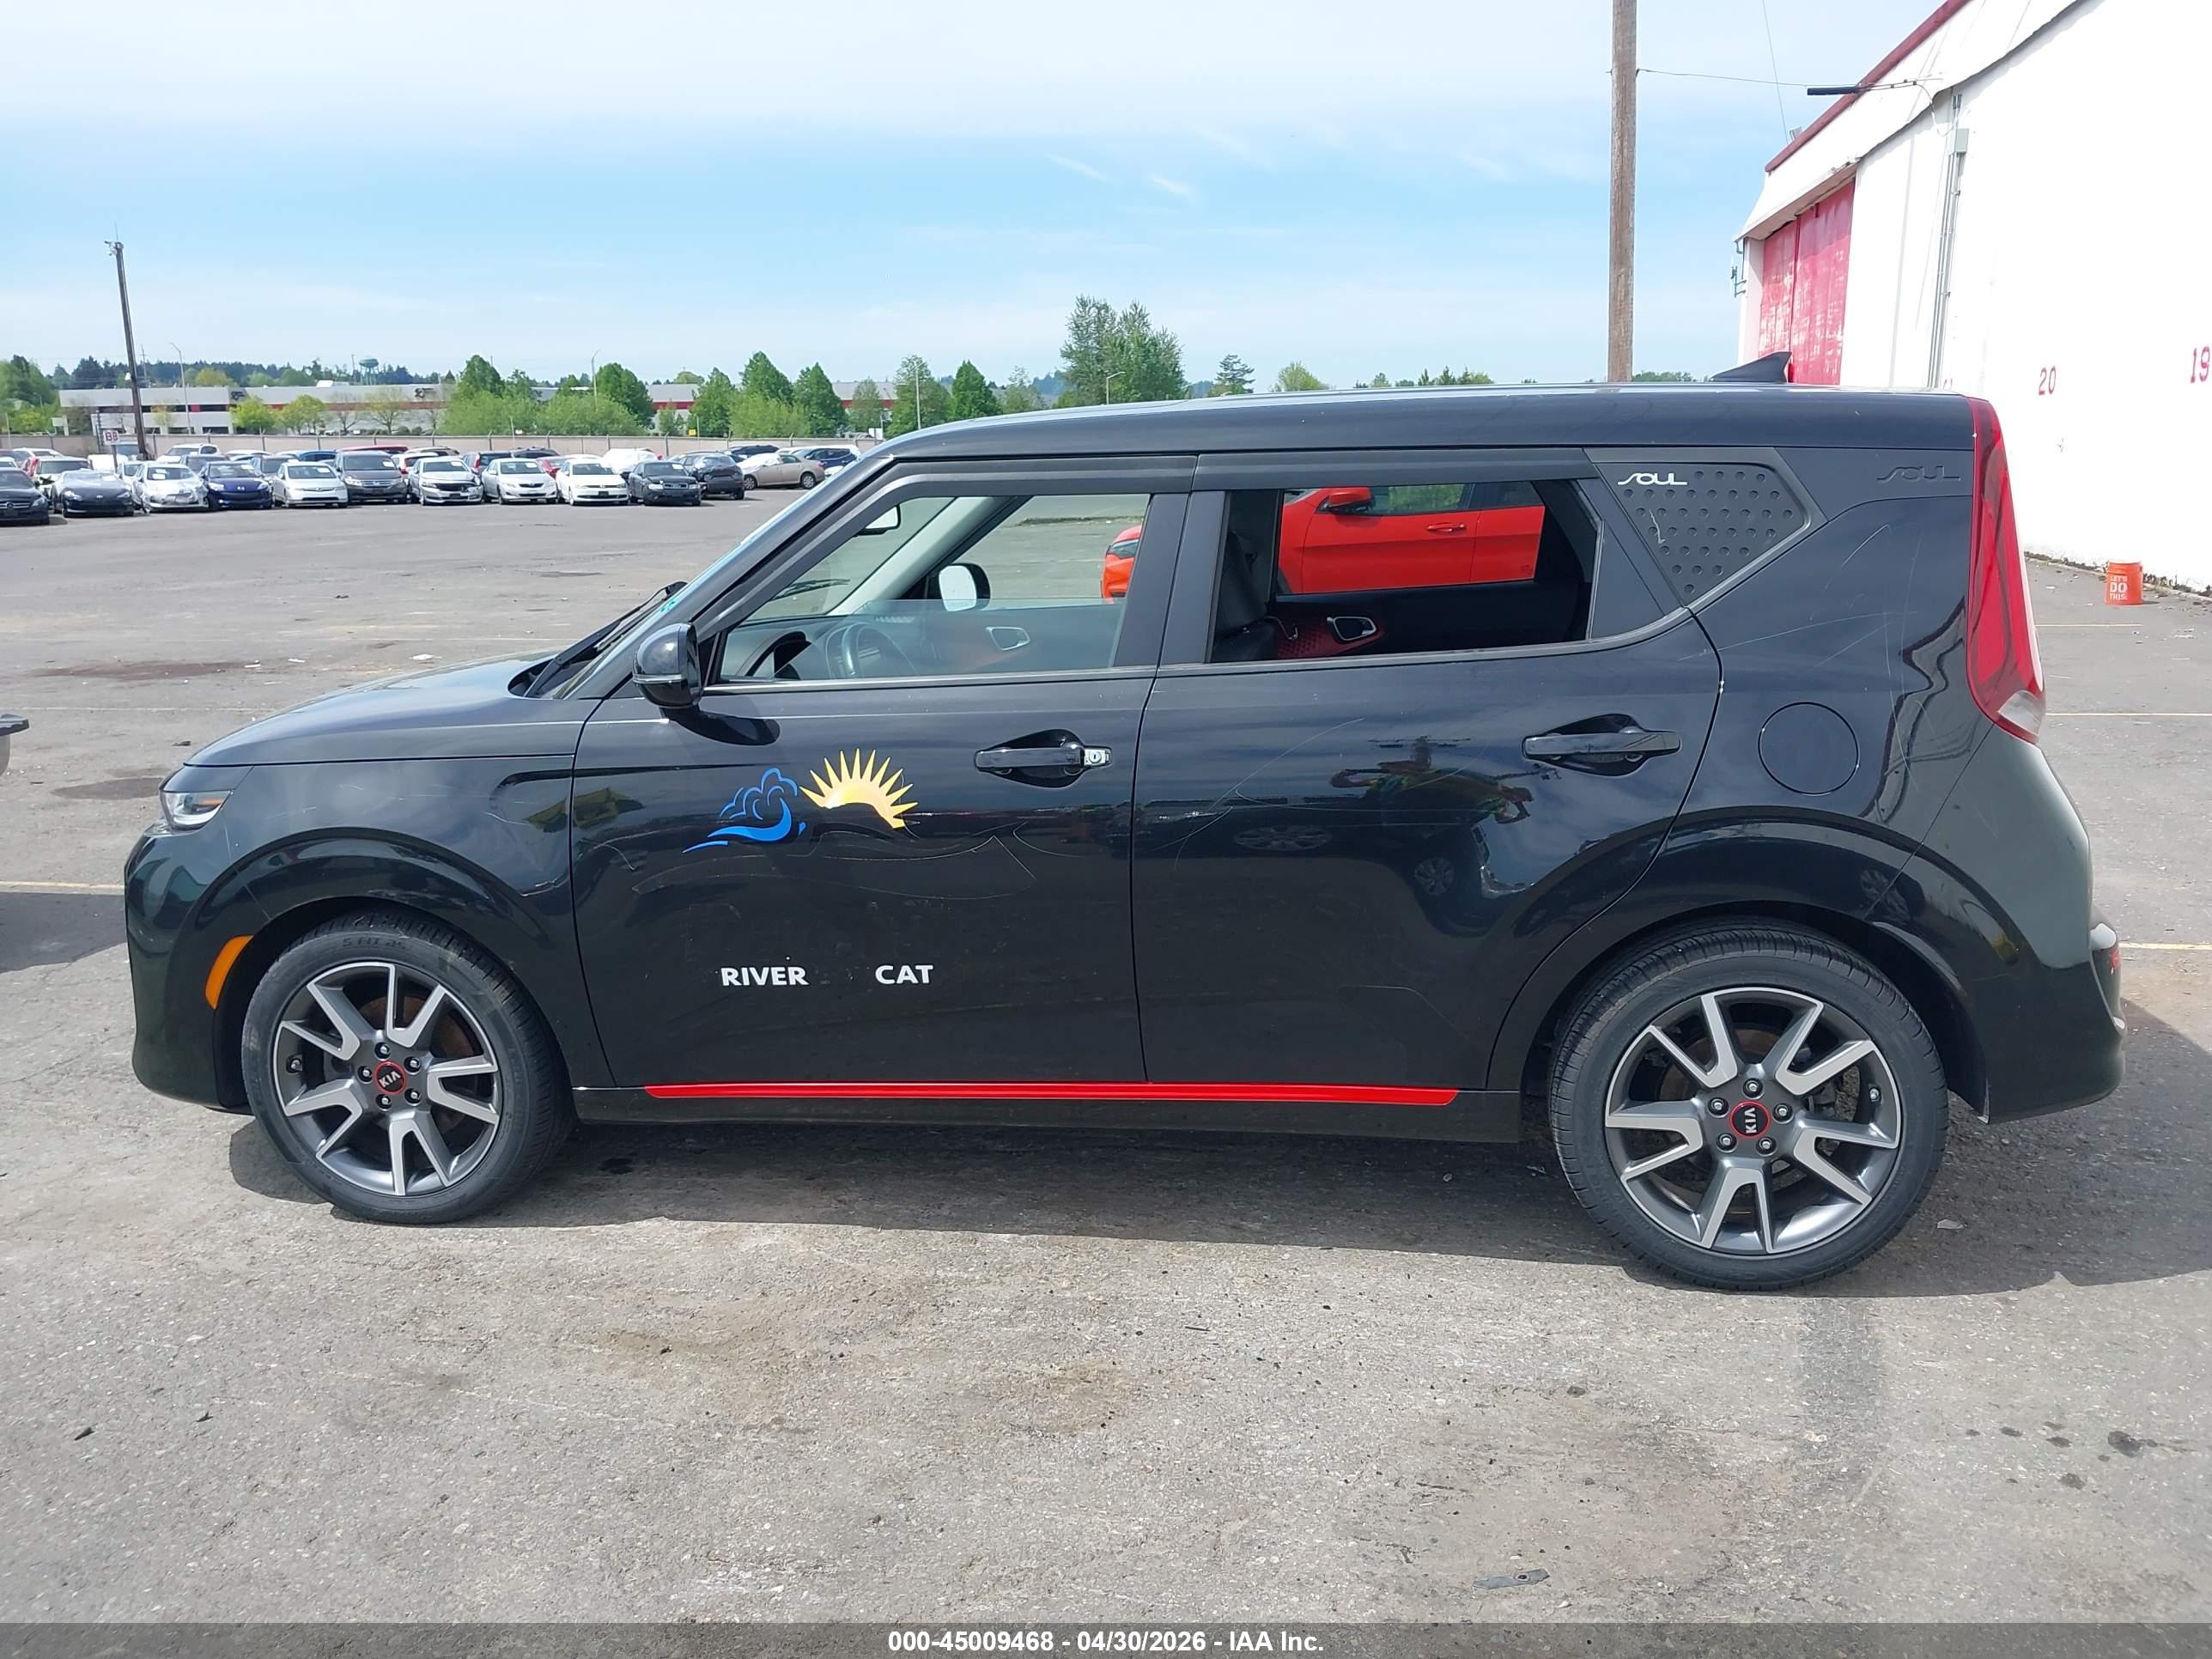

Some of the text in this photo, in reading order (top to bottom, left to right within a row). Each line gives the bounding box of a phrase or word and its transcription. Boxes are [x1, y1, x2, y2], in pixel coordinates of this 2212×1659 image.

[2191, 346, 2210, 383] 19
[2039, 366, 2057, 396] 20
[1617, 472, 1688, 485] SOUL
[1876, 465, 1961, 483] SOUL
[2110, 582, 2129, 592] DO
[720, 964, 933, 986] RIVER CAT
[379, 1071, 401, 1088] KIA
[1744, 1107, 1758, 1134] KIA
